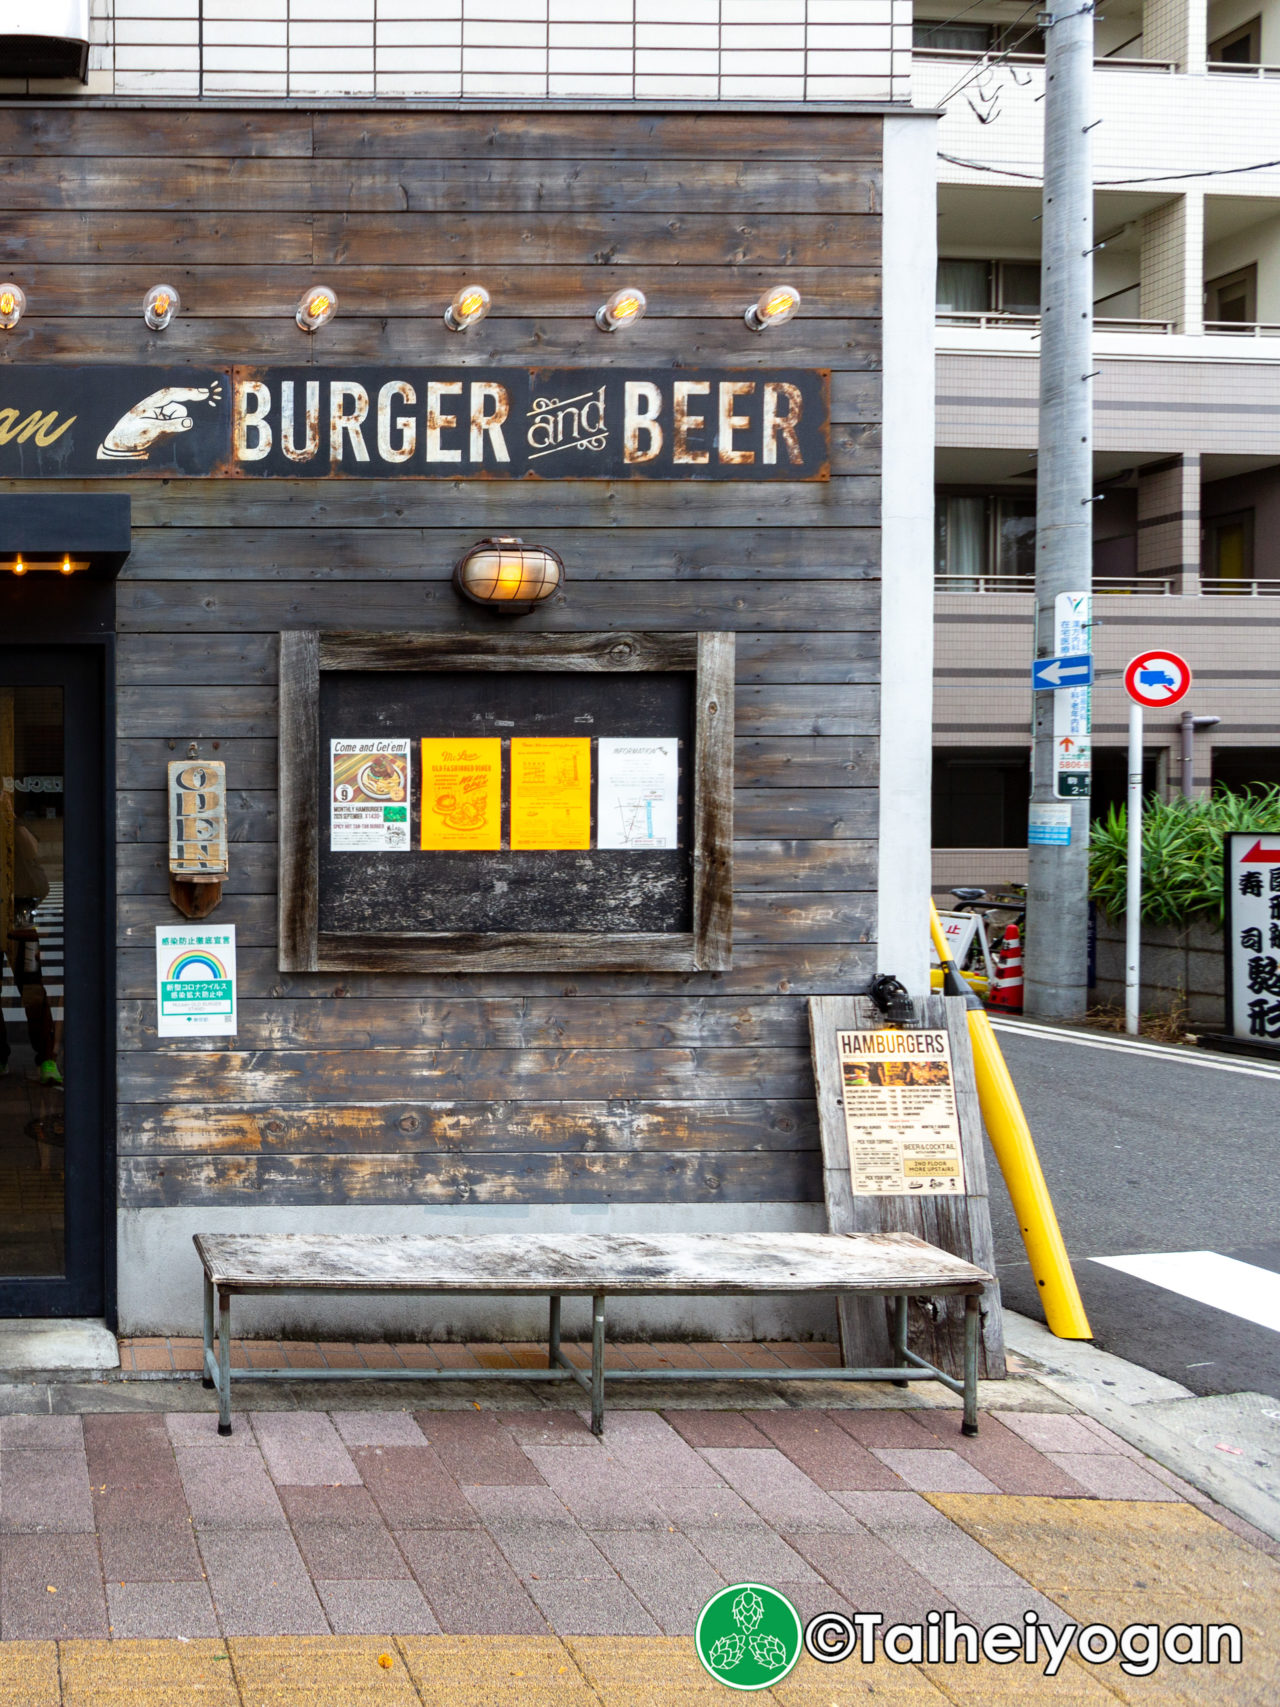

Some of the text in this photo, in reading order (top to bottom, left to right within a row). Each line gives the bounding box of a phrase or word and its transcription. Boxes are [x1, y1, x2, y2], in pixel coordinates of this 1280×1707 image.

[238, 380, 805, 465] BURGER and BEER
[334, 741, 357, 752] Come
[358, 741, 374, 752] and
[341, 789, 348, 801] 9
[166, 983, 227, 992] 新型コロナウイルス
[841, 1034, 945, 1054] HAMBURGERS
